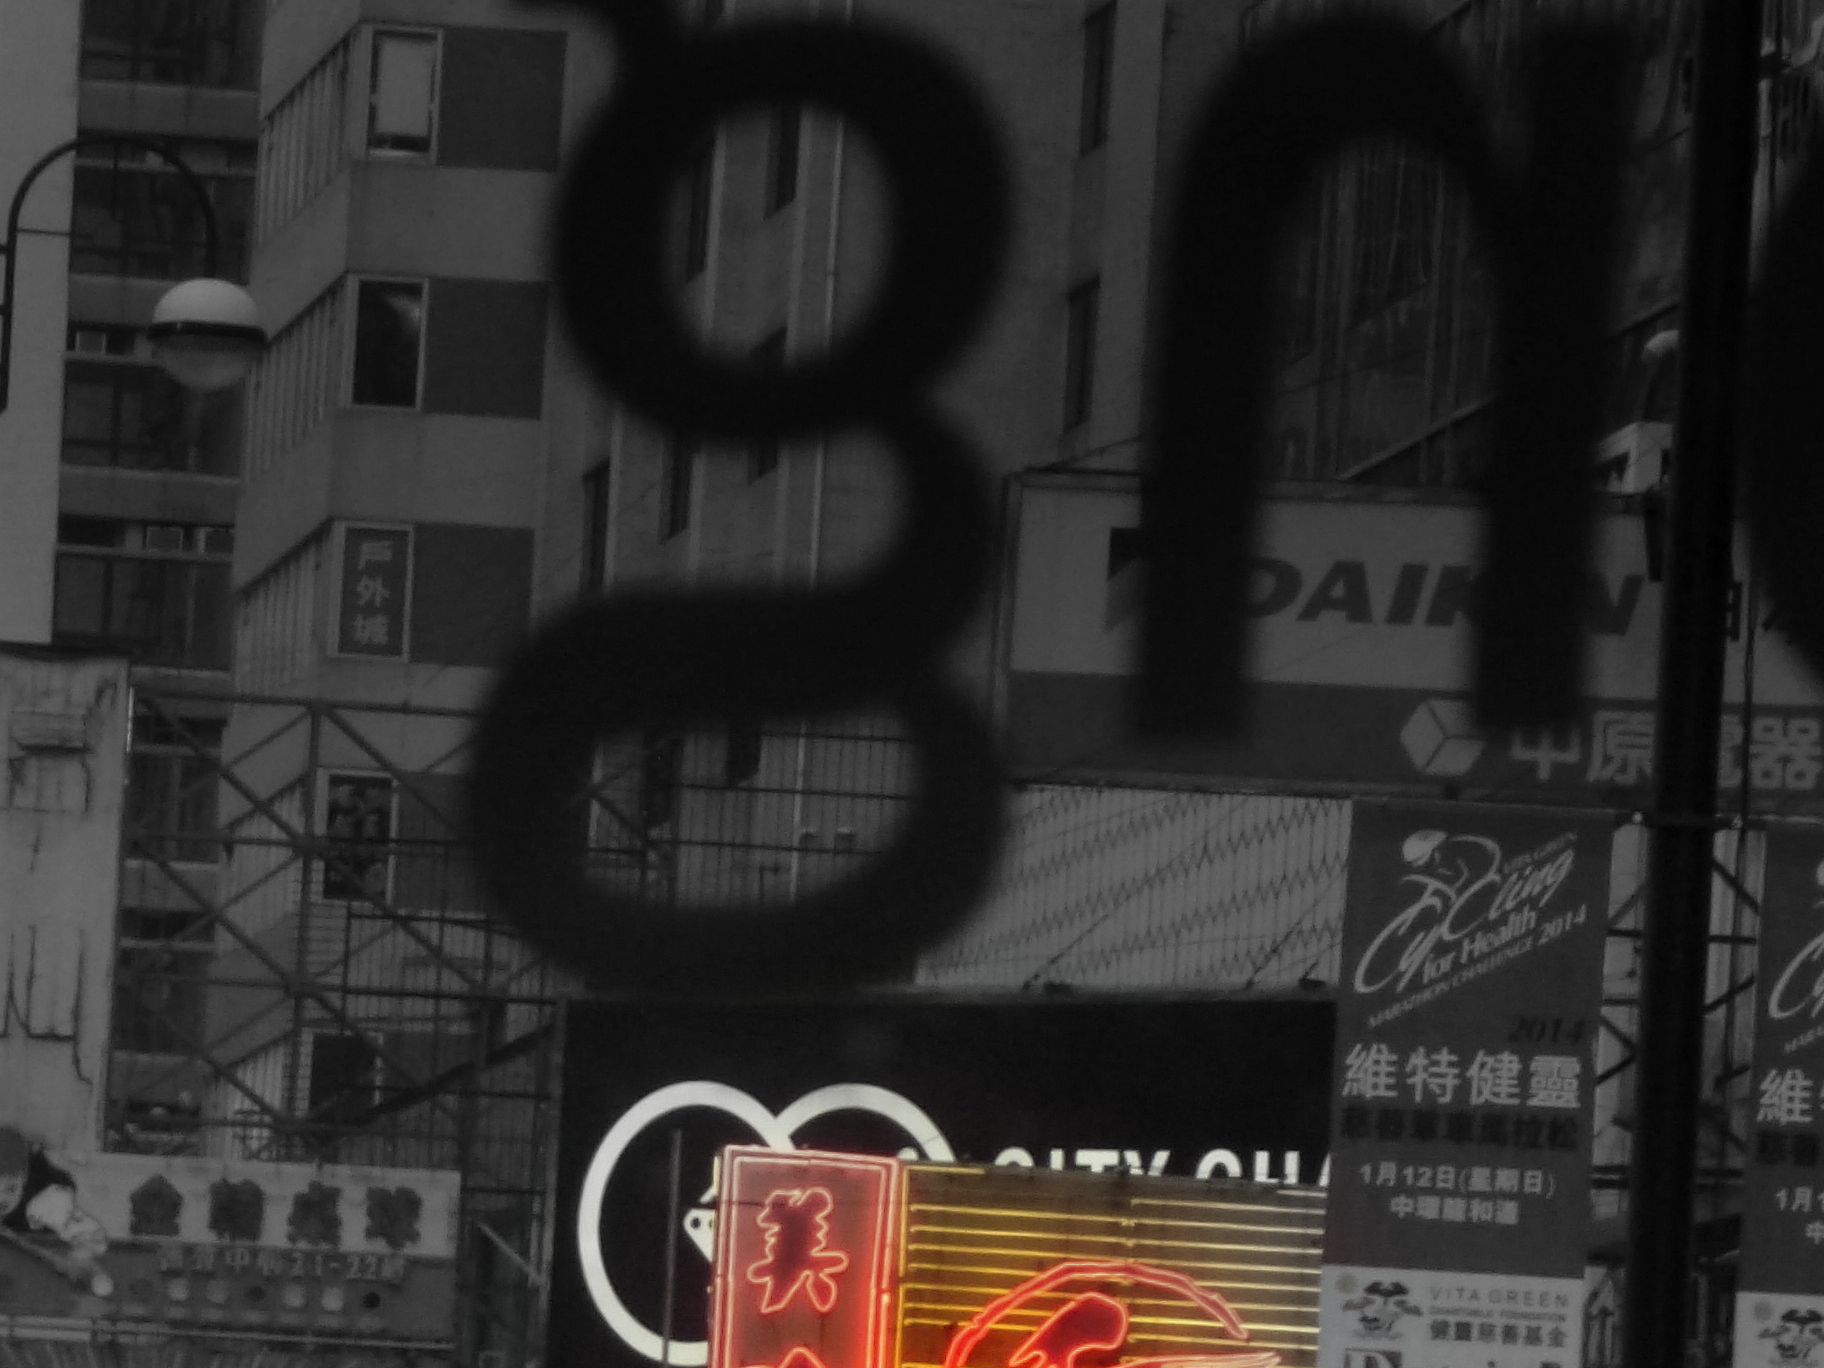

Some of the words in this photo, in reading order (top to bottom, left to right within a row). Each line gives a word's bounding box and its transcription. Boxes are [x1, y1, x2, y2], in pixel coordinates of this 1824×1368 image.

[1236, 557, 1644, 636] DAIKN
[1423, 950, 1456, 985] for
[1460, 903, 1538, 964] Health
[1537, 903, 1587, 947] 2014
[1507, 1017, 1586, 1046] 2014
[1342, 1043, 1582, 1109] 維特健靈
[1755, 1067, 1824, 1128] 維
[1429, 1284, 1480, 1301] VITA
[1487, 1288, 1569, 1308] GREEN
